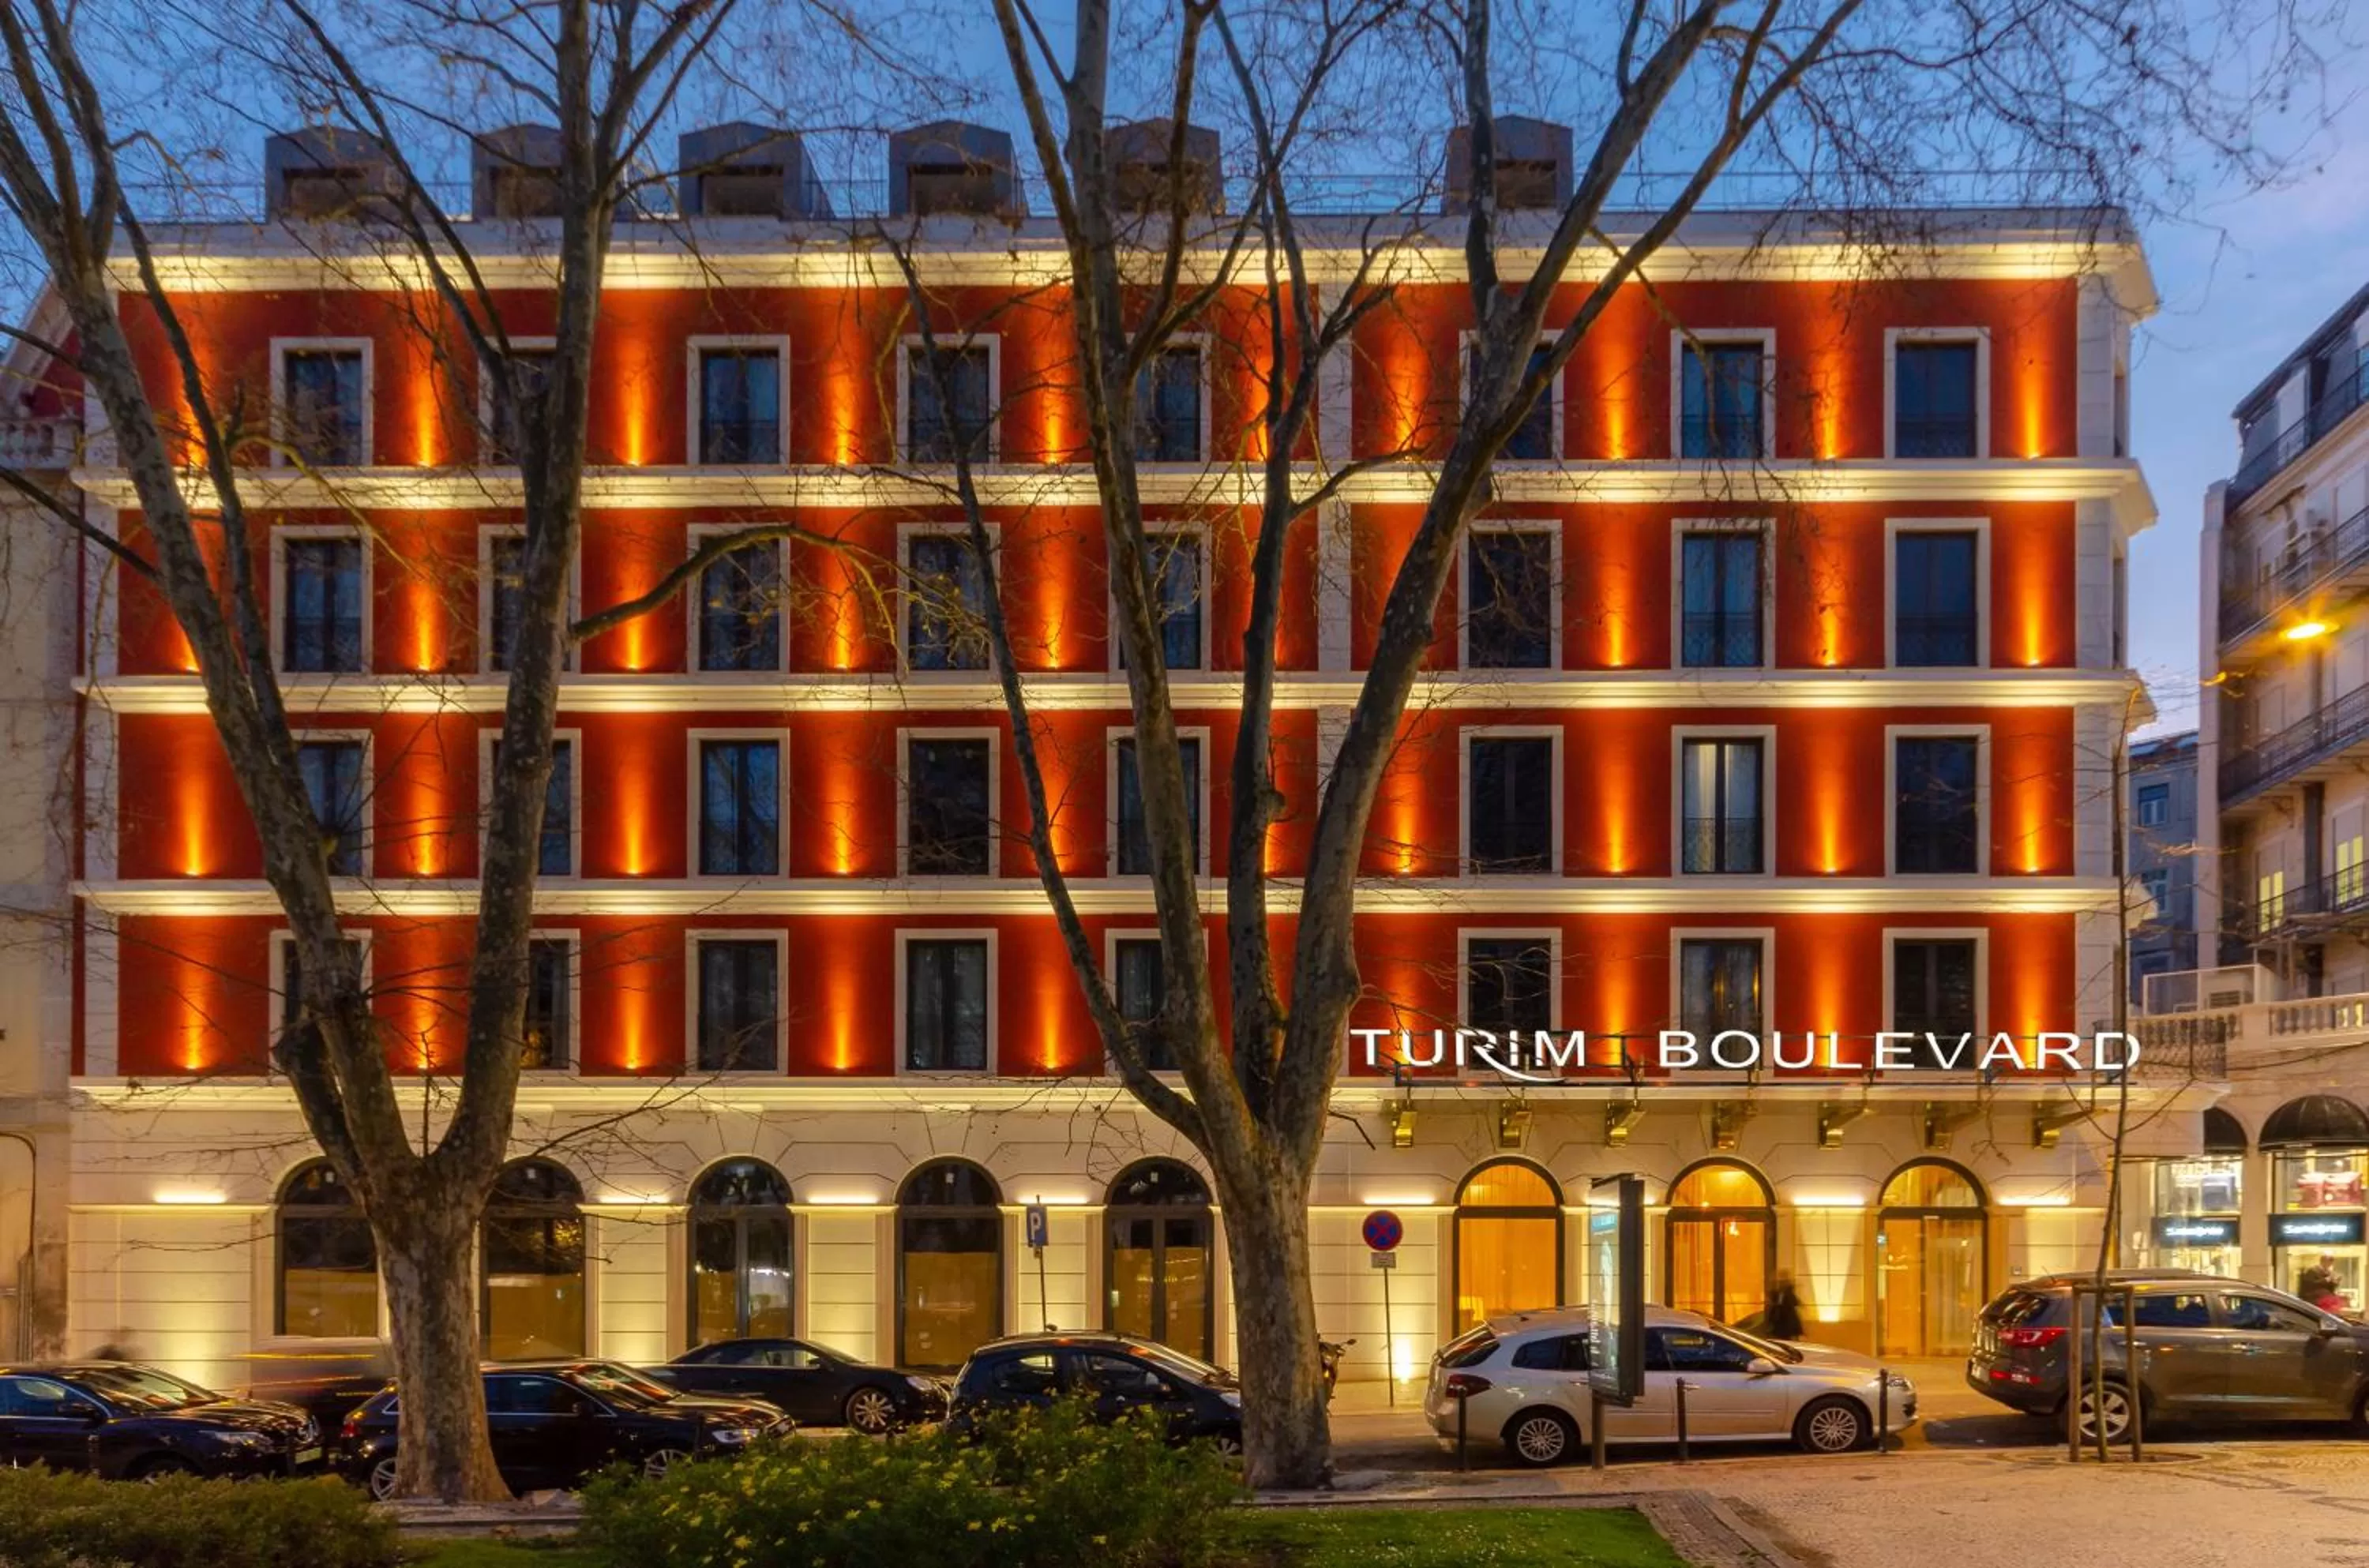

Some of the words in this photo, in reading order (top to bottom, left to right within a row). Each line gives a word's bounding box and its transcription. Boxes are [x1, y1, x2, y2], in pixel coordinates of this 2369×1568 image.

[1350, 1029, 1586, 1082] TURIM
[1659, 1030, 2141, 1070] BOULEVARD
[1029, 1212, 1042, 1240] P
